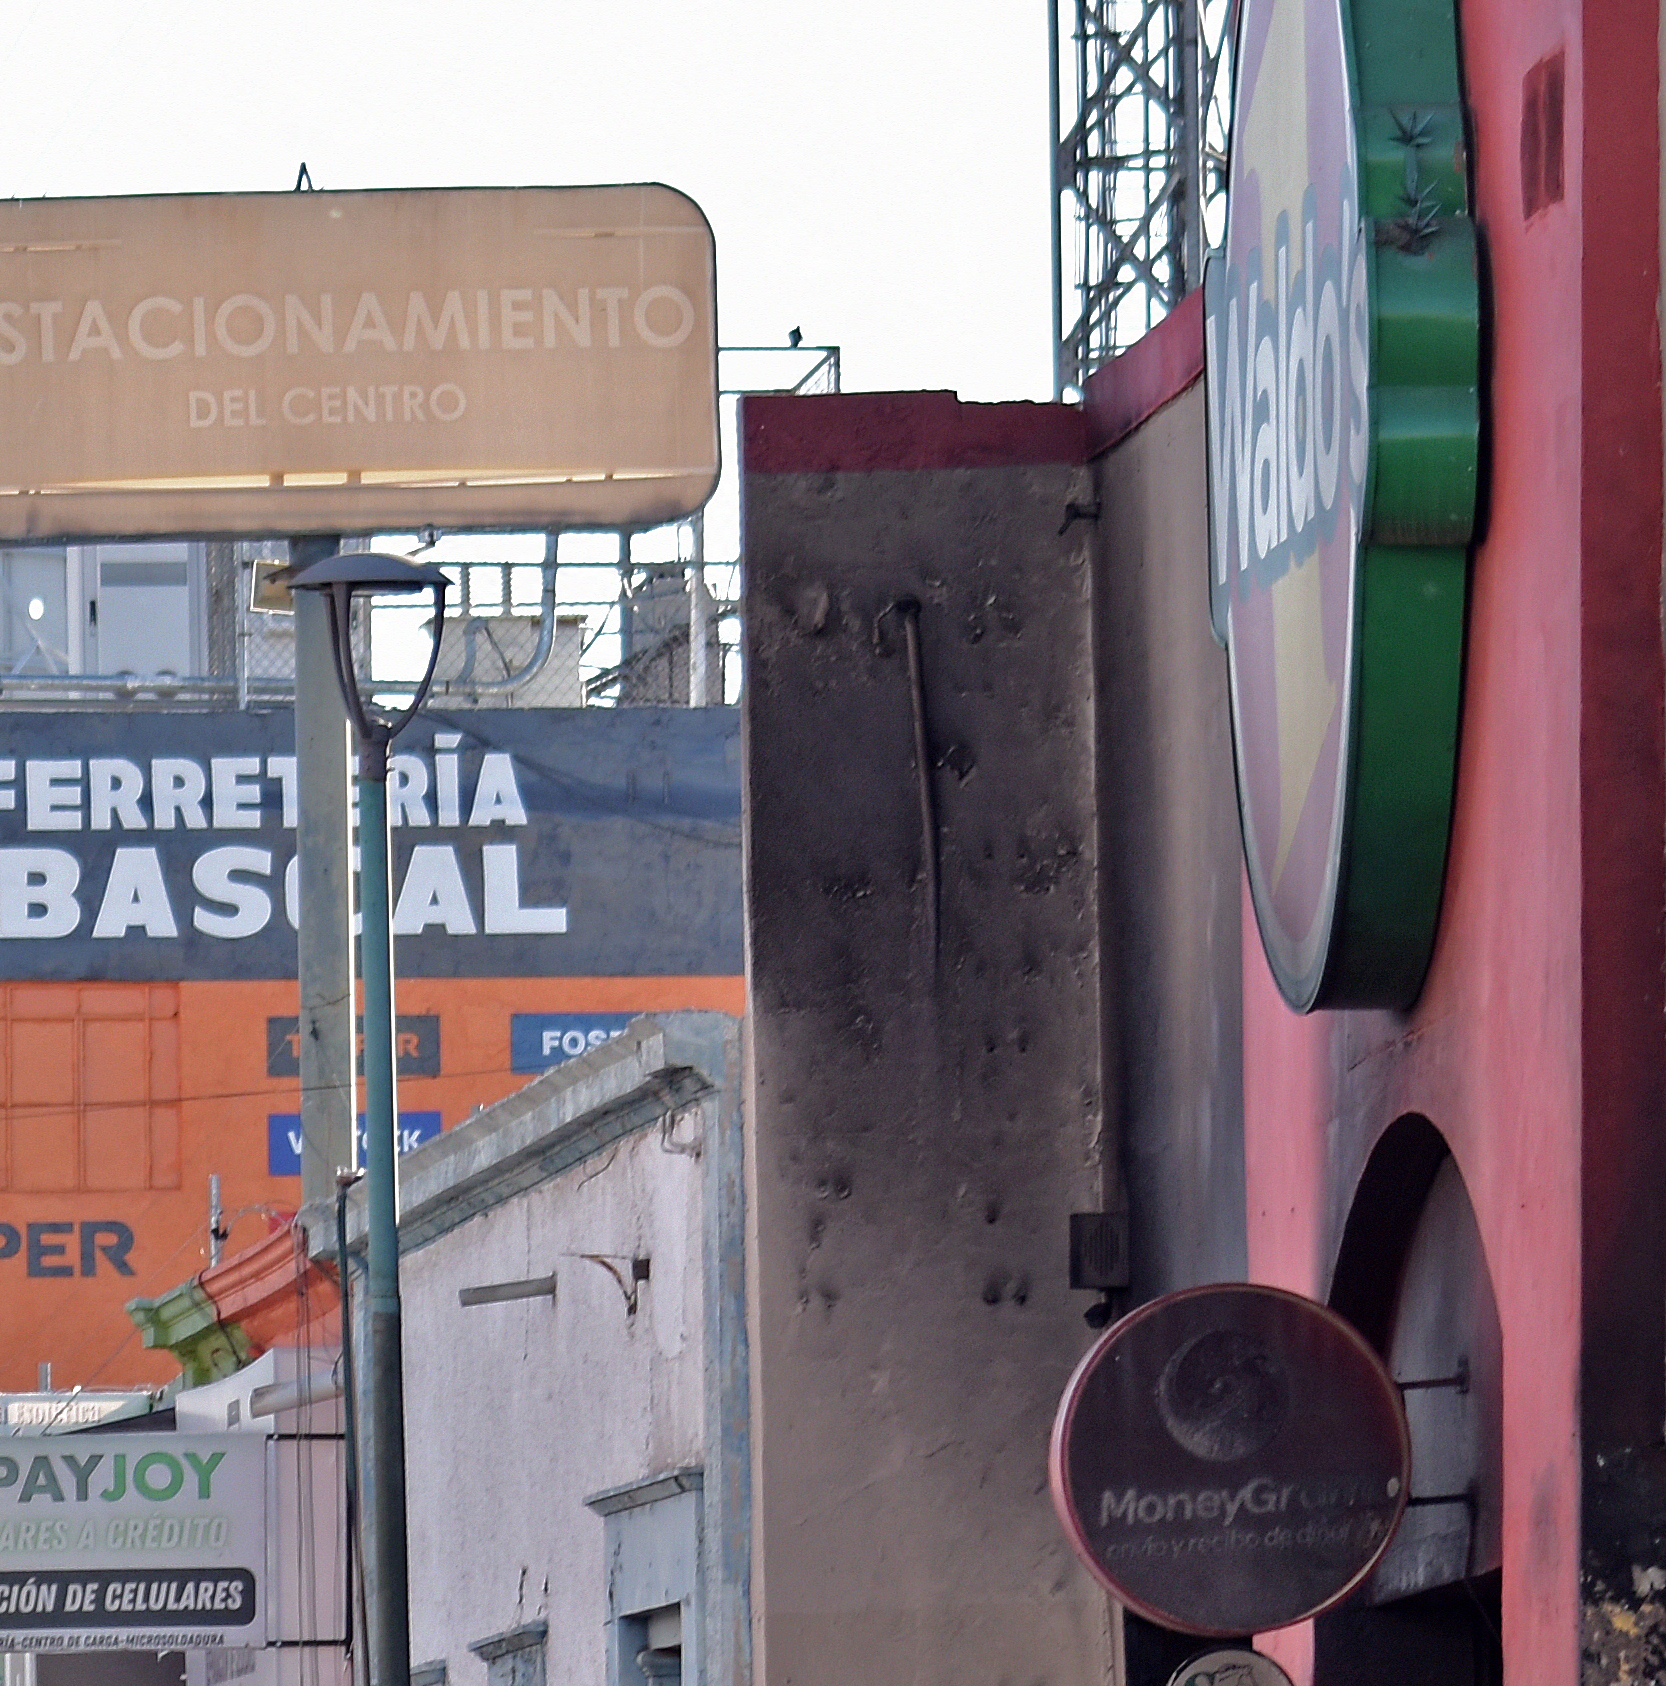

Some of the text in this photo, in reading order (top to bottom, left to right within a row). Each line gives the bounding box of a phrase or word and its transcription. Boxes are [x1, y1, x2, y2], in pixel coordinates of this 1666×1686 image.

[188, 383, 468, 428] DEL CENTRO
[1206, 198, 1368, 586] Waldo's
[78, 1517, 98, 1550] A
[106, 1512, 231, 1552] CRÉDITO
[64, 1582, 100, 1613] DE
[103, 1579, 245, 1613] CELULARES
